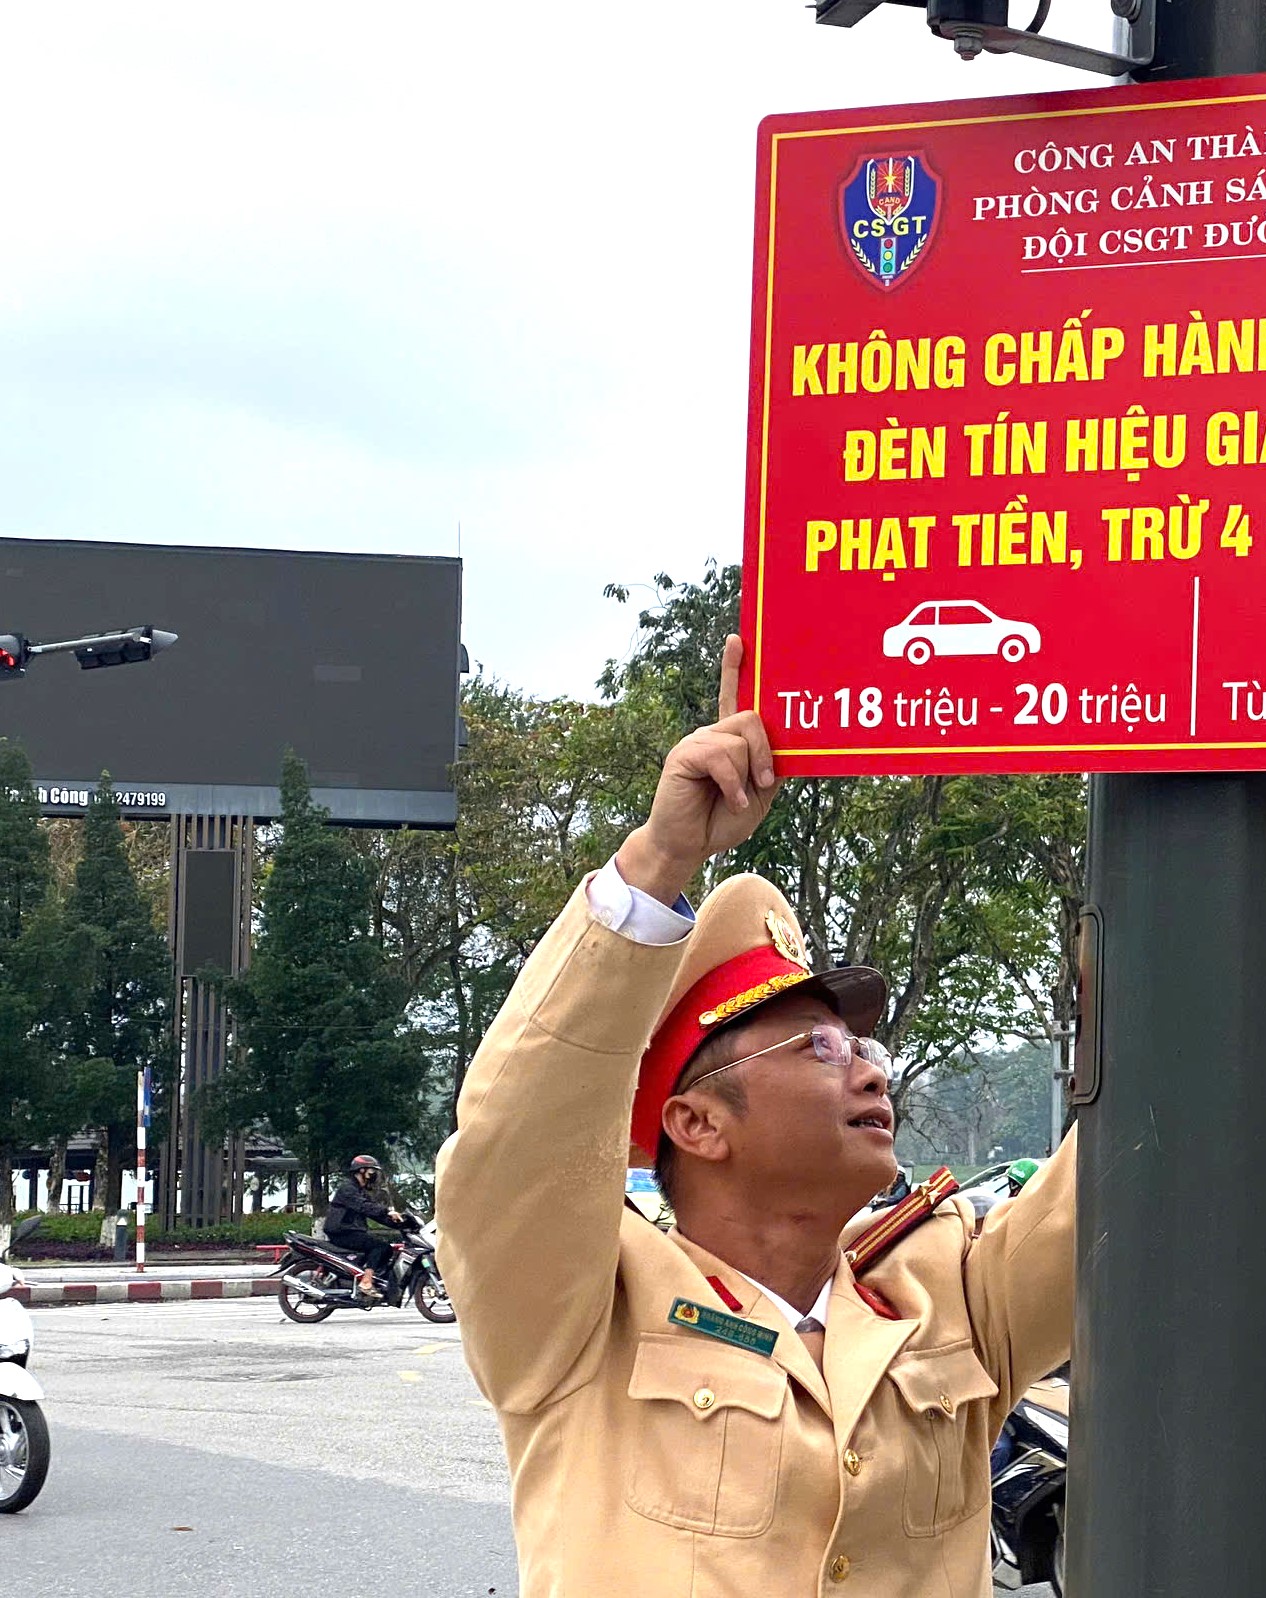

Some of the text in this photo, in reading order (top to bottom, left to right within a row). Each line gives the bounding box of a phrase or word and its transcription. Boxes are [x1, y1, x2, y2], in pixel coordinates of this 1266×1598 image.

[1015, 142, 1114, 173] CÔNG
[1125, 139, 1176, 165] AN
[973, 186, 1099, 220] PHÒNG
[1111, 175, 1213, 210] CẢNH
[1021, 227, 1088, 264] ĐỘI
[1099, 225, 1193, 255] CSGT
[792, 329, 966, 396] KHÔNG
[984, 309, 1125, 386] CHẤP
[843, 417, 946, 482] ĐÈN
[963, 411, 1047, 476] TÍN
[1065, 404, 1187, 482] HIỆU
[805, 516, 936, 582] PHẠT
[952, 494, 1082, 570] TIỀN,
[1101, 494, 1209, 562] TRỪ
[1220, 504, 1252, 557] 4
[777, 689, 823, 729] Từ
[833, 686, 883, 728] 18
[894, 689, 978, 735] triệu
[1013, 682, 1068, 725] 20
[1078, 683, 1166, 732] triệu
[50, 787, 88, 806] Công
